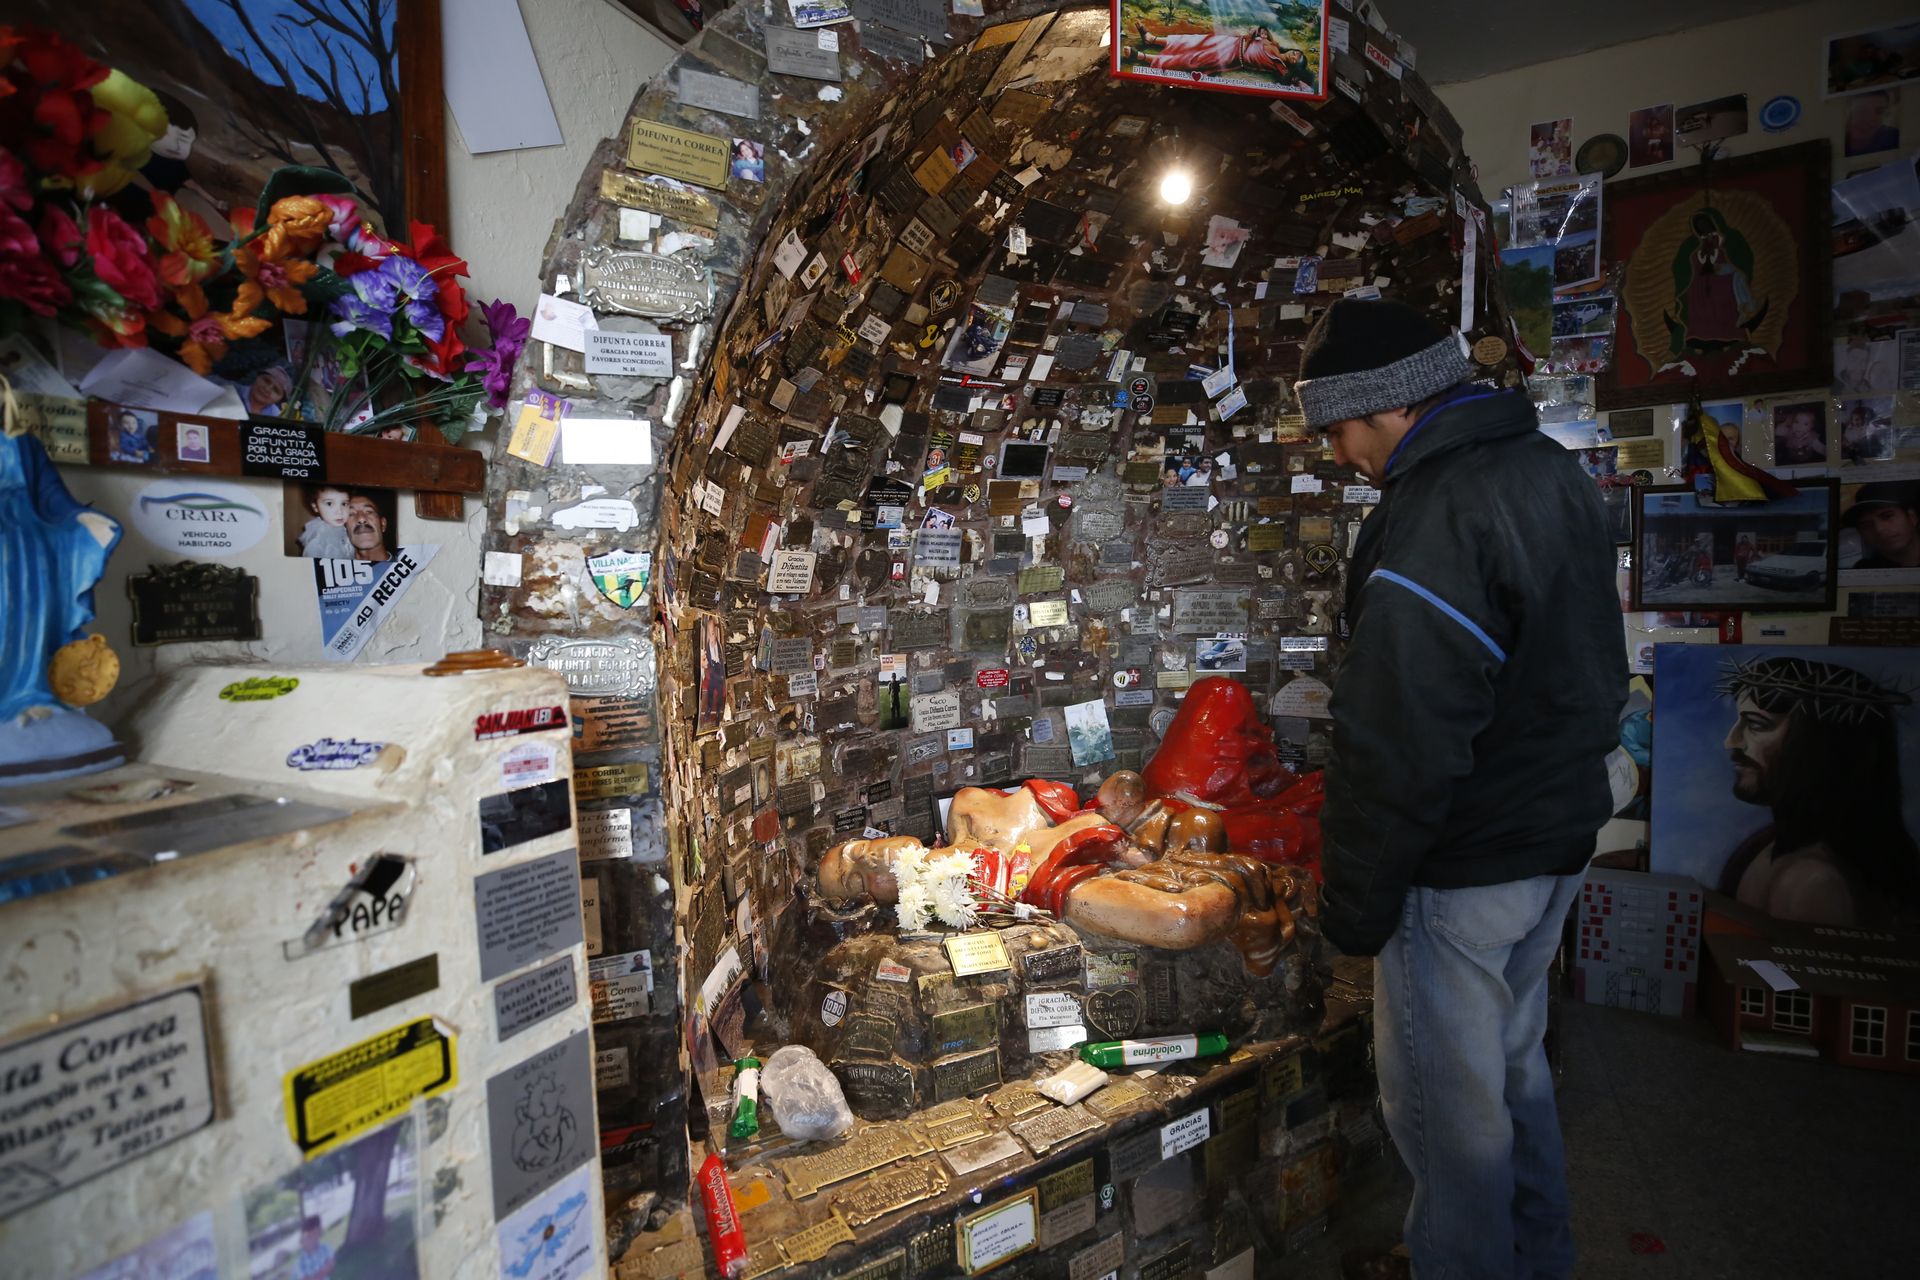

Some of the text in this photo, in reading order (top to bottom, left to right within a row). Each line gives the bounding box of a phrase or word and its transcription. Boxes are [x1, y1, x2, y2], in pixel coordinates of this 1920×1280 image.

[1366, 46, 1391, 70] ROMA
[1132, 65, 1163, 74] DIFUNTA
[637, 128, 724, 156] DIFUNTA CORREA
[600, 259, 643, 276] DIFUNTA
[593, 336, 667, 348] DIFUNTA CORREA
[253, 427, 306, 439] GRACIAS
[249, 436, 315, 449] DIFUNTITA
[248, 445, 316, 457] POR LA GRACIA
[246, 454, 320, 467] CONCEDIDA
[282, 468, 308, 477] RDG
[166, 509, 239, 523] CRARA
[182, 531, 228, 539] VEHICULO
[178, 540, 232, 548] HABILITADO
[593, 558, 615, 568] VILLA
[781, 562, 808, 571] Difuntita
[320, 559, 374, 588] 105
[372, 554, 417, 606] RECCE
[322, 586, 363, 594] CAMPEONATO
[356, 606, 373, 627] 40
[571, 647, 615, 659] GRACIAS
[548, 659, 638, 671] DIFUNTA CORREA
[592, 769, 625, 778] CORREA
[594, 823, 629, 834] Correa
[333, 893, 405, 938] PAPA
[1813, 926, 1897, 943] GRACIAS
[1770, 945, 1855, 963] DIFUNTA
[610, 985, 643, 996] Correa
[1030, 1004, 1079, 1015] DIFUNTA CORREA
[59, 1015, 177, 1073] Correa
[1132, 1044, 1182, 1057] Golondrina
[93, 1096, 185, 1146] Tatiana
[1170, 1114, 1202, 1136] GRACIAS
[1188, 1124, 1208, 1137] CORREA
[706, 1166, 737, 1238] Malambo
[787, 1218, 840, 1246] GRACIAS
